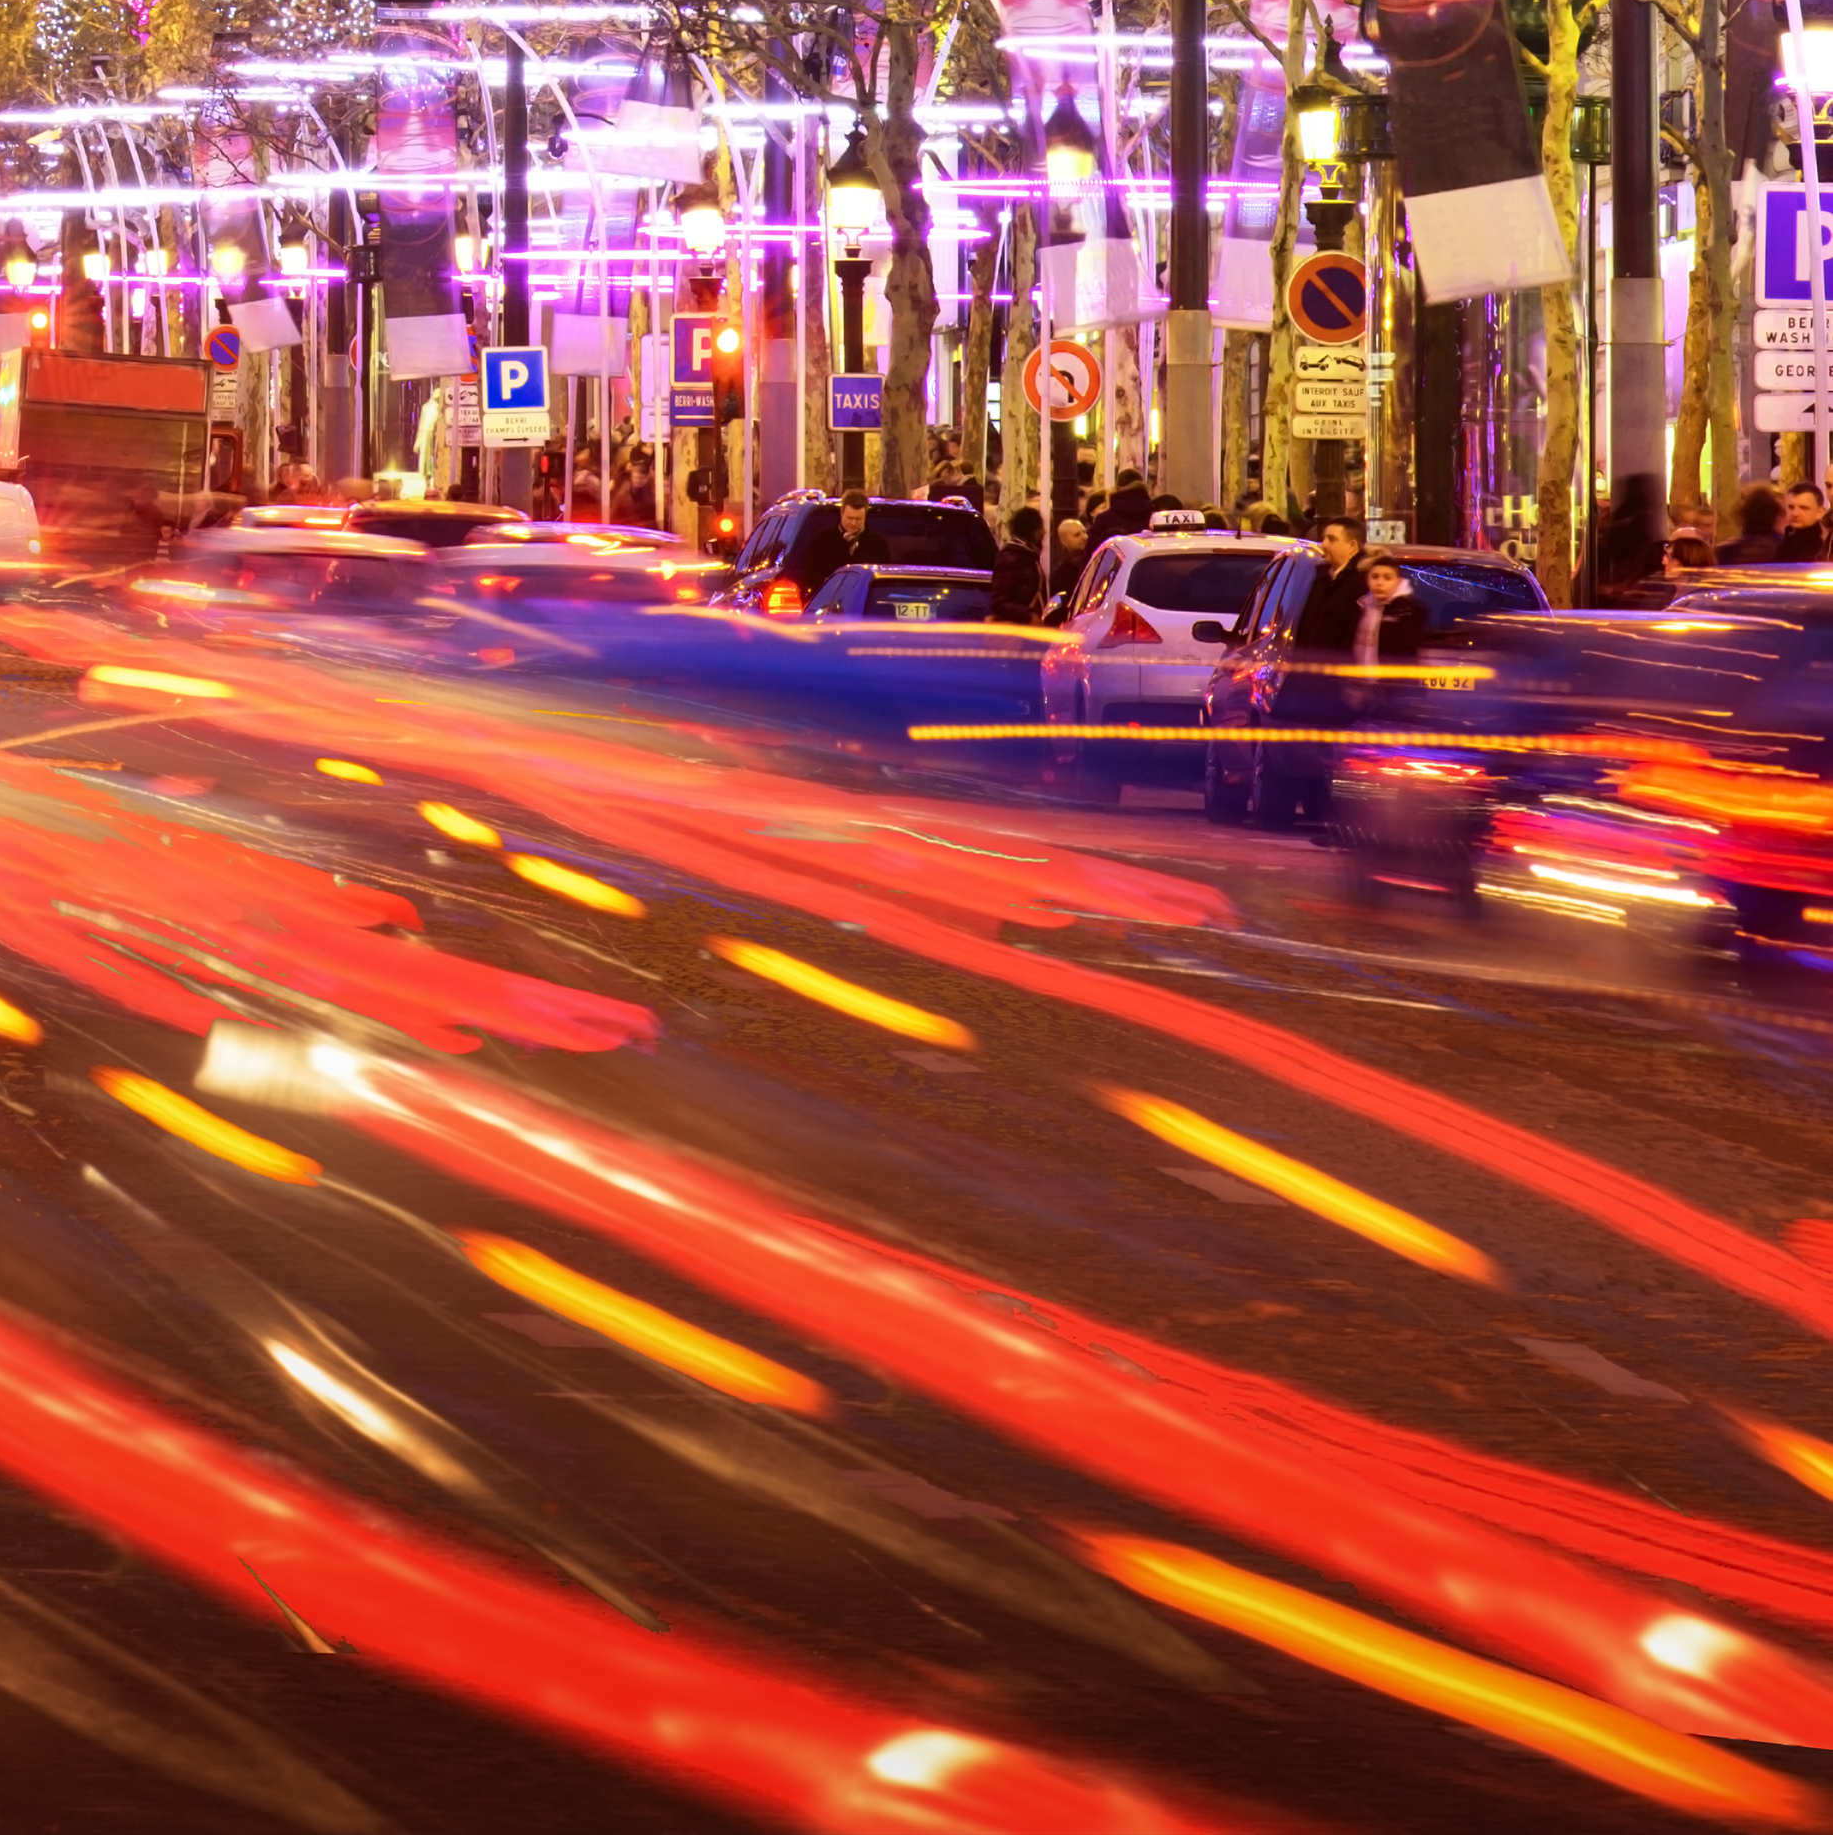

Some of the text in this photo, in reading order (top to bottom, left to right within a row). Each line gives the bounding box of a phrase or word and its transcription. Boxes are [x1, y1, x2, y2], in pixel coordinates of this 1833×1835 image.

[1795, 210, 1833, 282] P
[692, 328, 712, 371] P
[500, 360, 529, 401] P
[1302, 387, 1364, 397] INTERDIT SAUF
[834, 393, 880, 410] TAXIS
[1310, 399, 1356, 408] AUX TAXIS
[1164, 514, 1195, 524] TAXI
